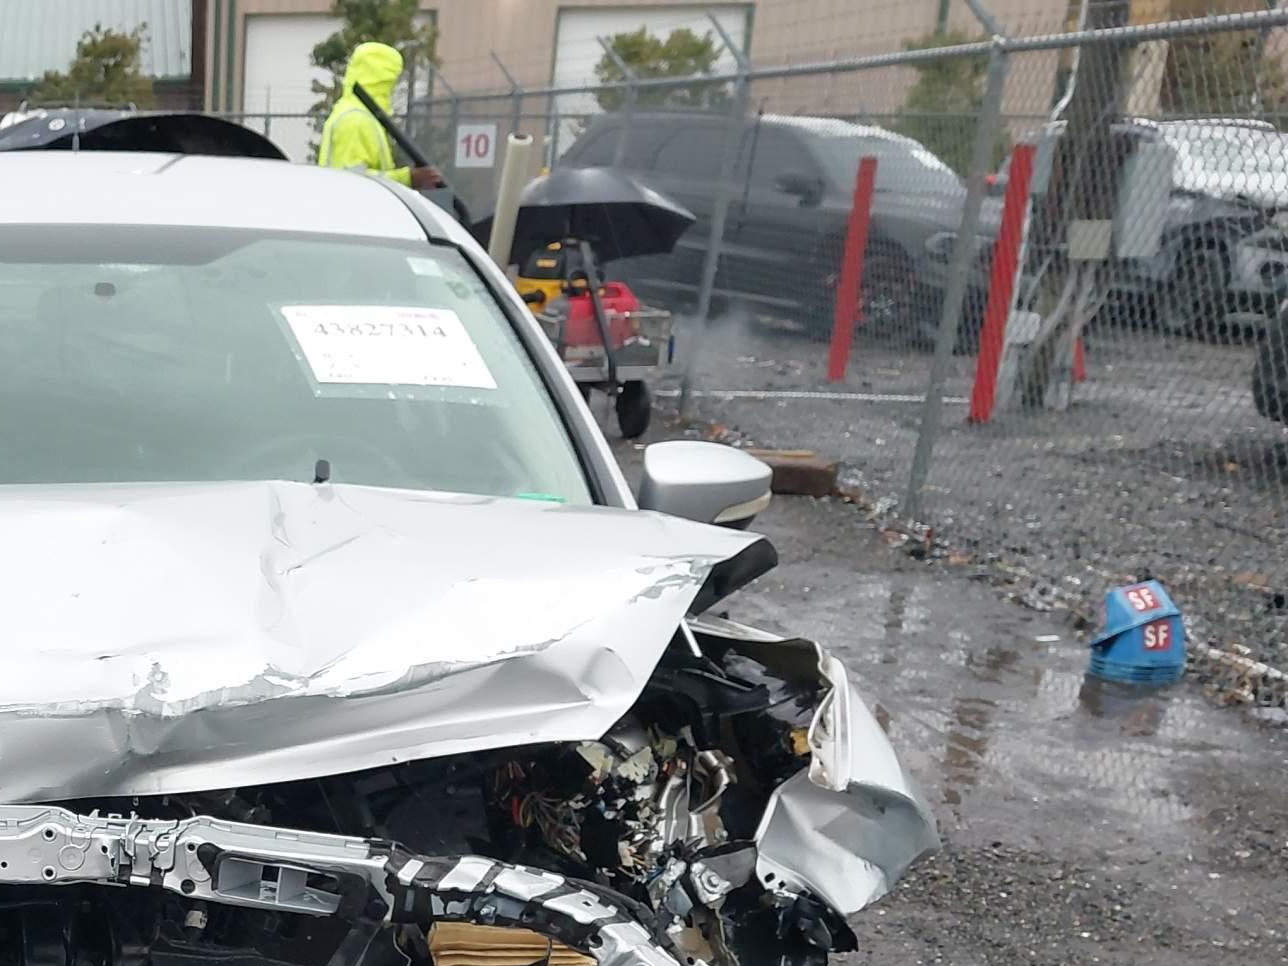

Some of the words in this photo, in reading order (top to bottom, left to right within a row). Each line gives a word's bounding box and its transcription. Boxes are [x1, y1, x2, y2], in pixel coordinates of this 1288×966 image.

[461, 133, 489, 158] 10
[1127, 588, 1154, 610] SF
[1144, 624, 1168, 648] SF
